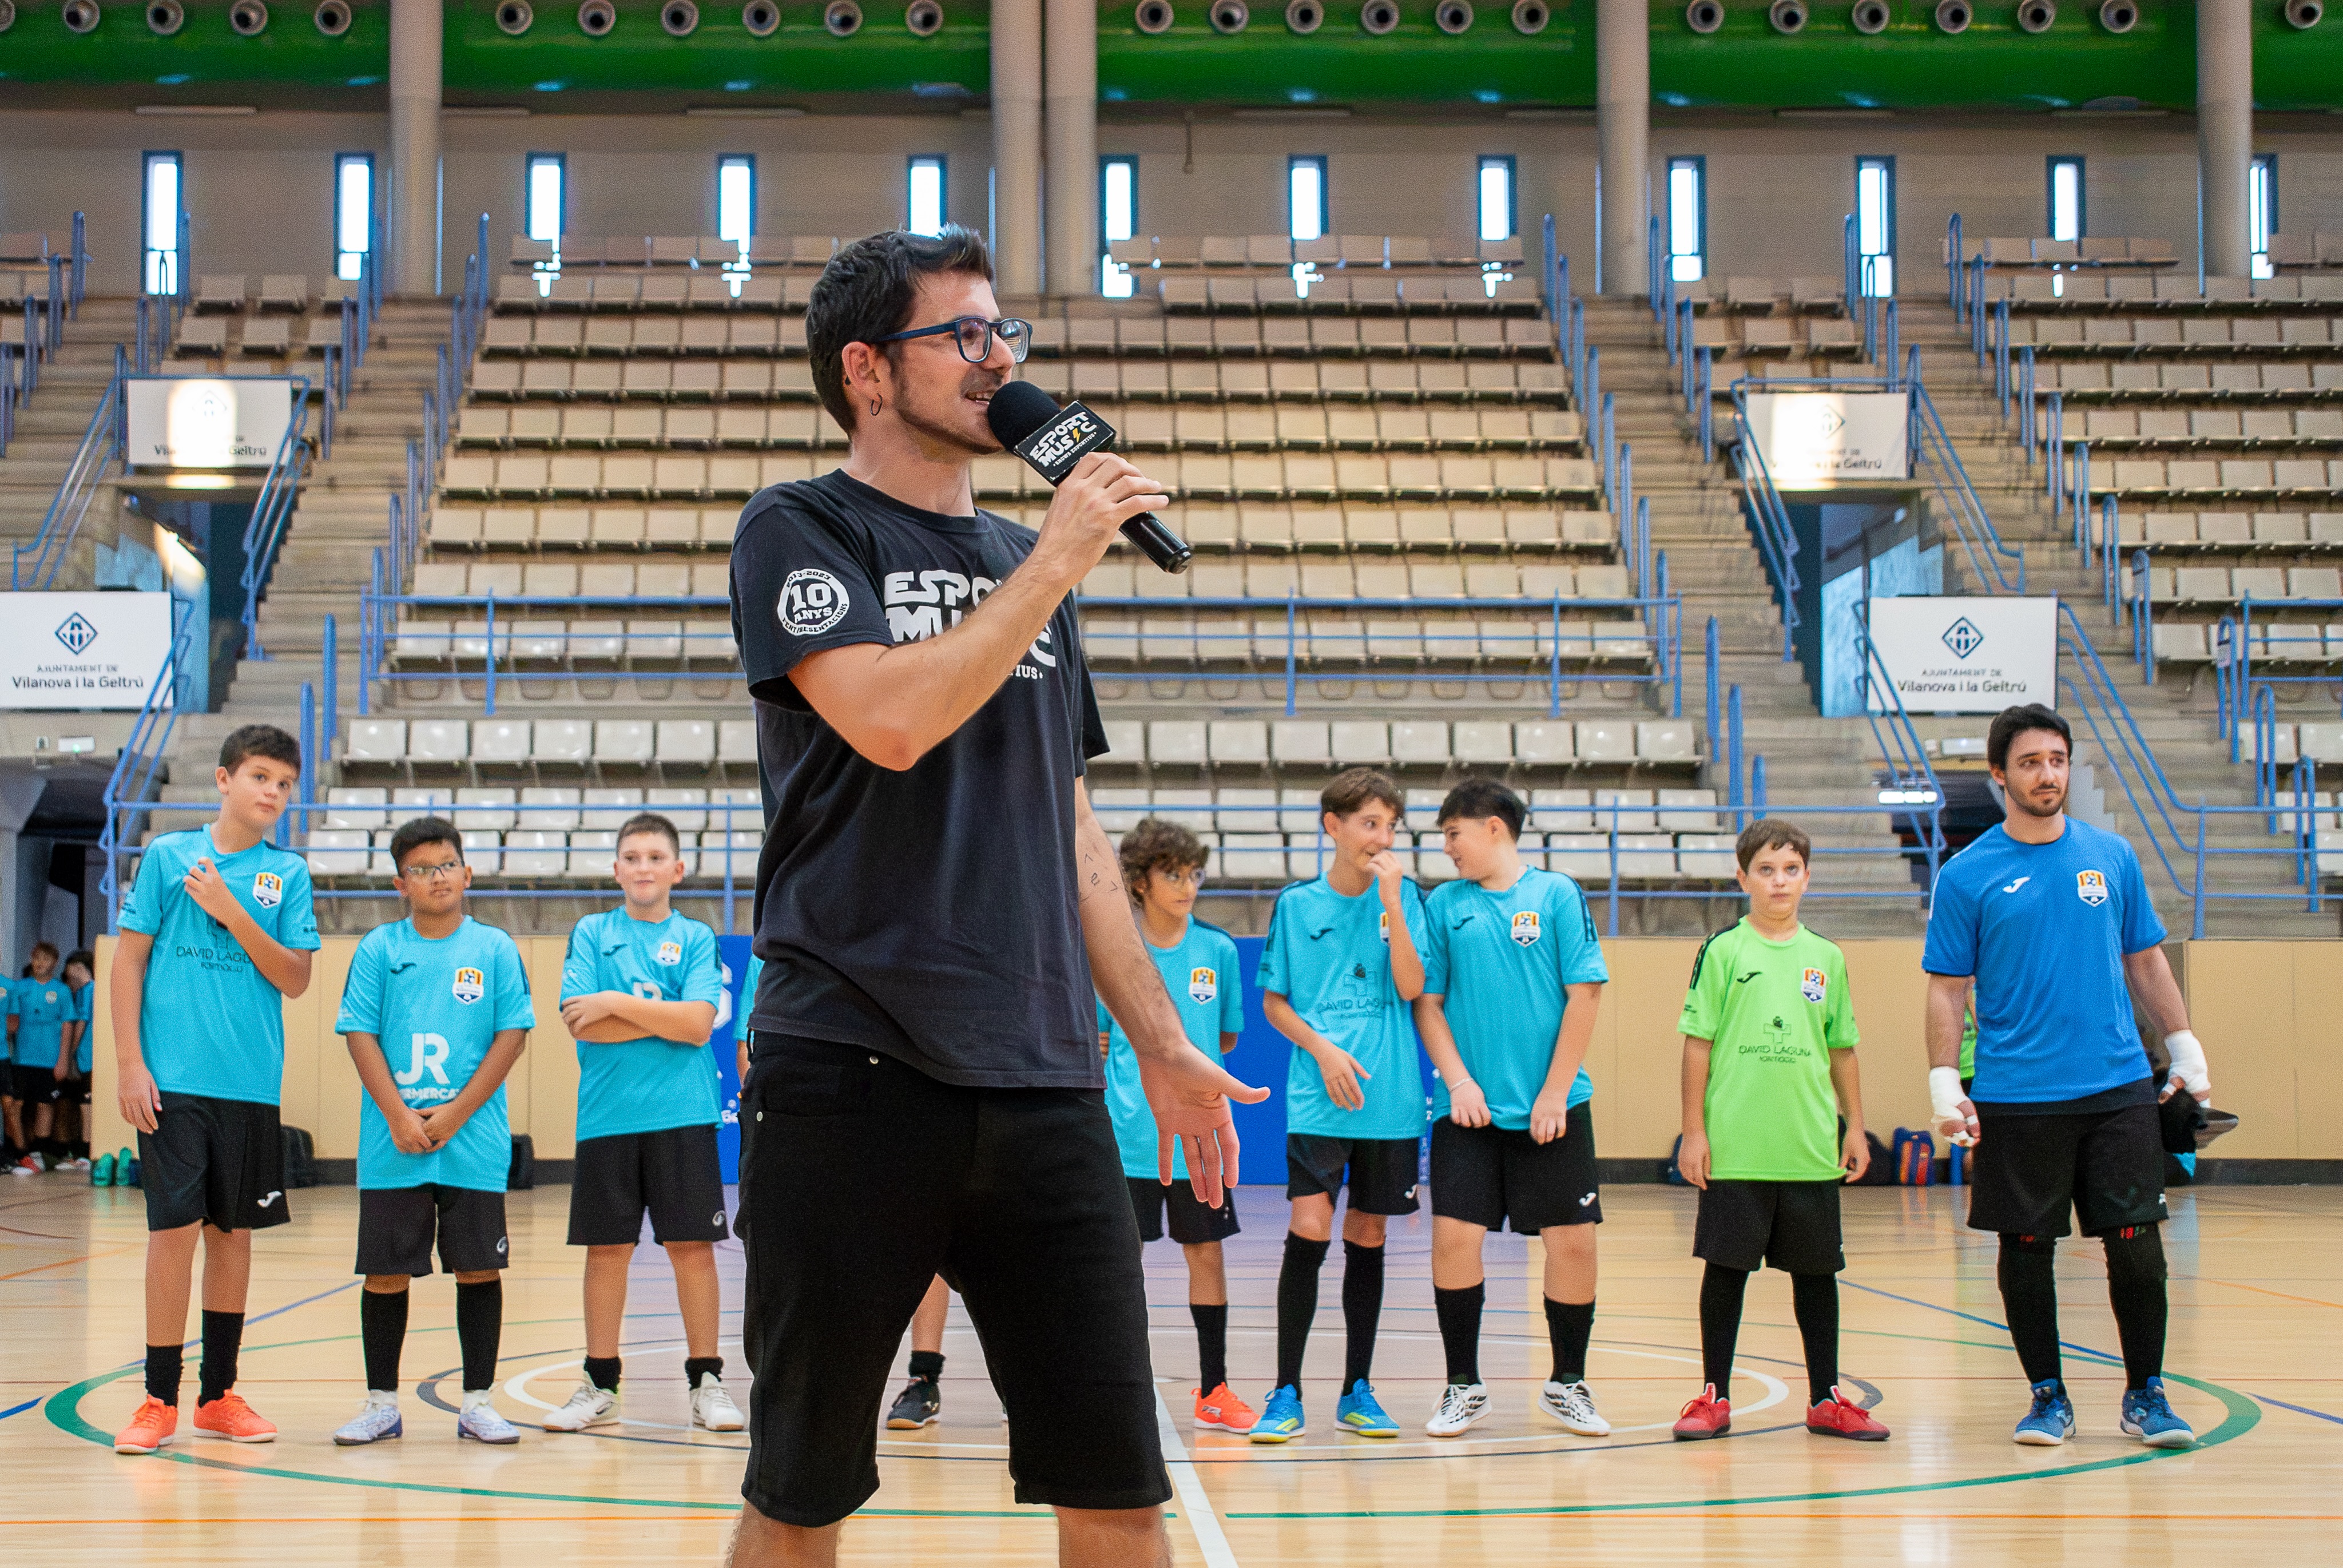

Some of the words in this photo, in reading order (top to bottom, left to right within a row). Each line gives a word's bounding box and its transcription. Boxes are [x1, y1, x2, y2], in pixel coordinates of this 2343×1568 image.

[1030, 411, 1088, 460] ESPORT
[885, 569, 1002, 607] ESPO
[791, 583, 832, 613] 10
[794, 607, 833, 624] ANYS
[12, 676, 72, 689] Vilanova
[76, 676, 79, 688] i
[84, 676, 94, 688] la
[99, 675, 144, 688] Geltrú
[1897, 680, 1956, 692] Vilanova
[1960, 680, 1963, 692] i
[1967, 680, 1978, 692] la
[1982, 680, 2027, 693] Geltrú
[176, 946, 213, 960] DAVID
[1739, 1045, 1771, 1054] DAVID
[394, 1033, 451, 1085] JR
